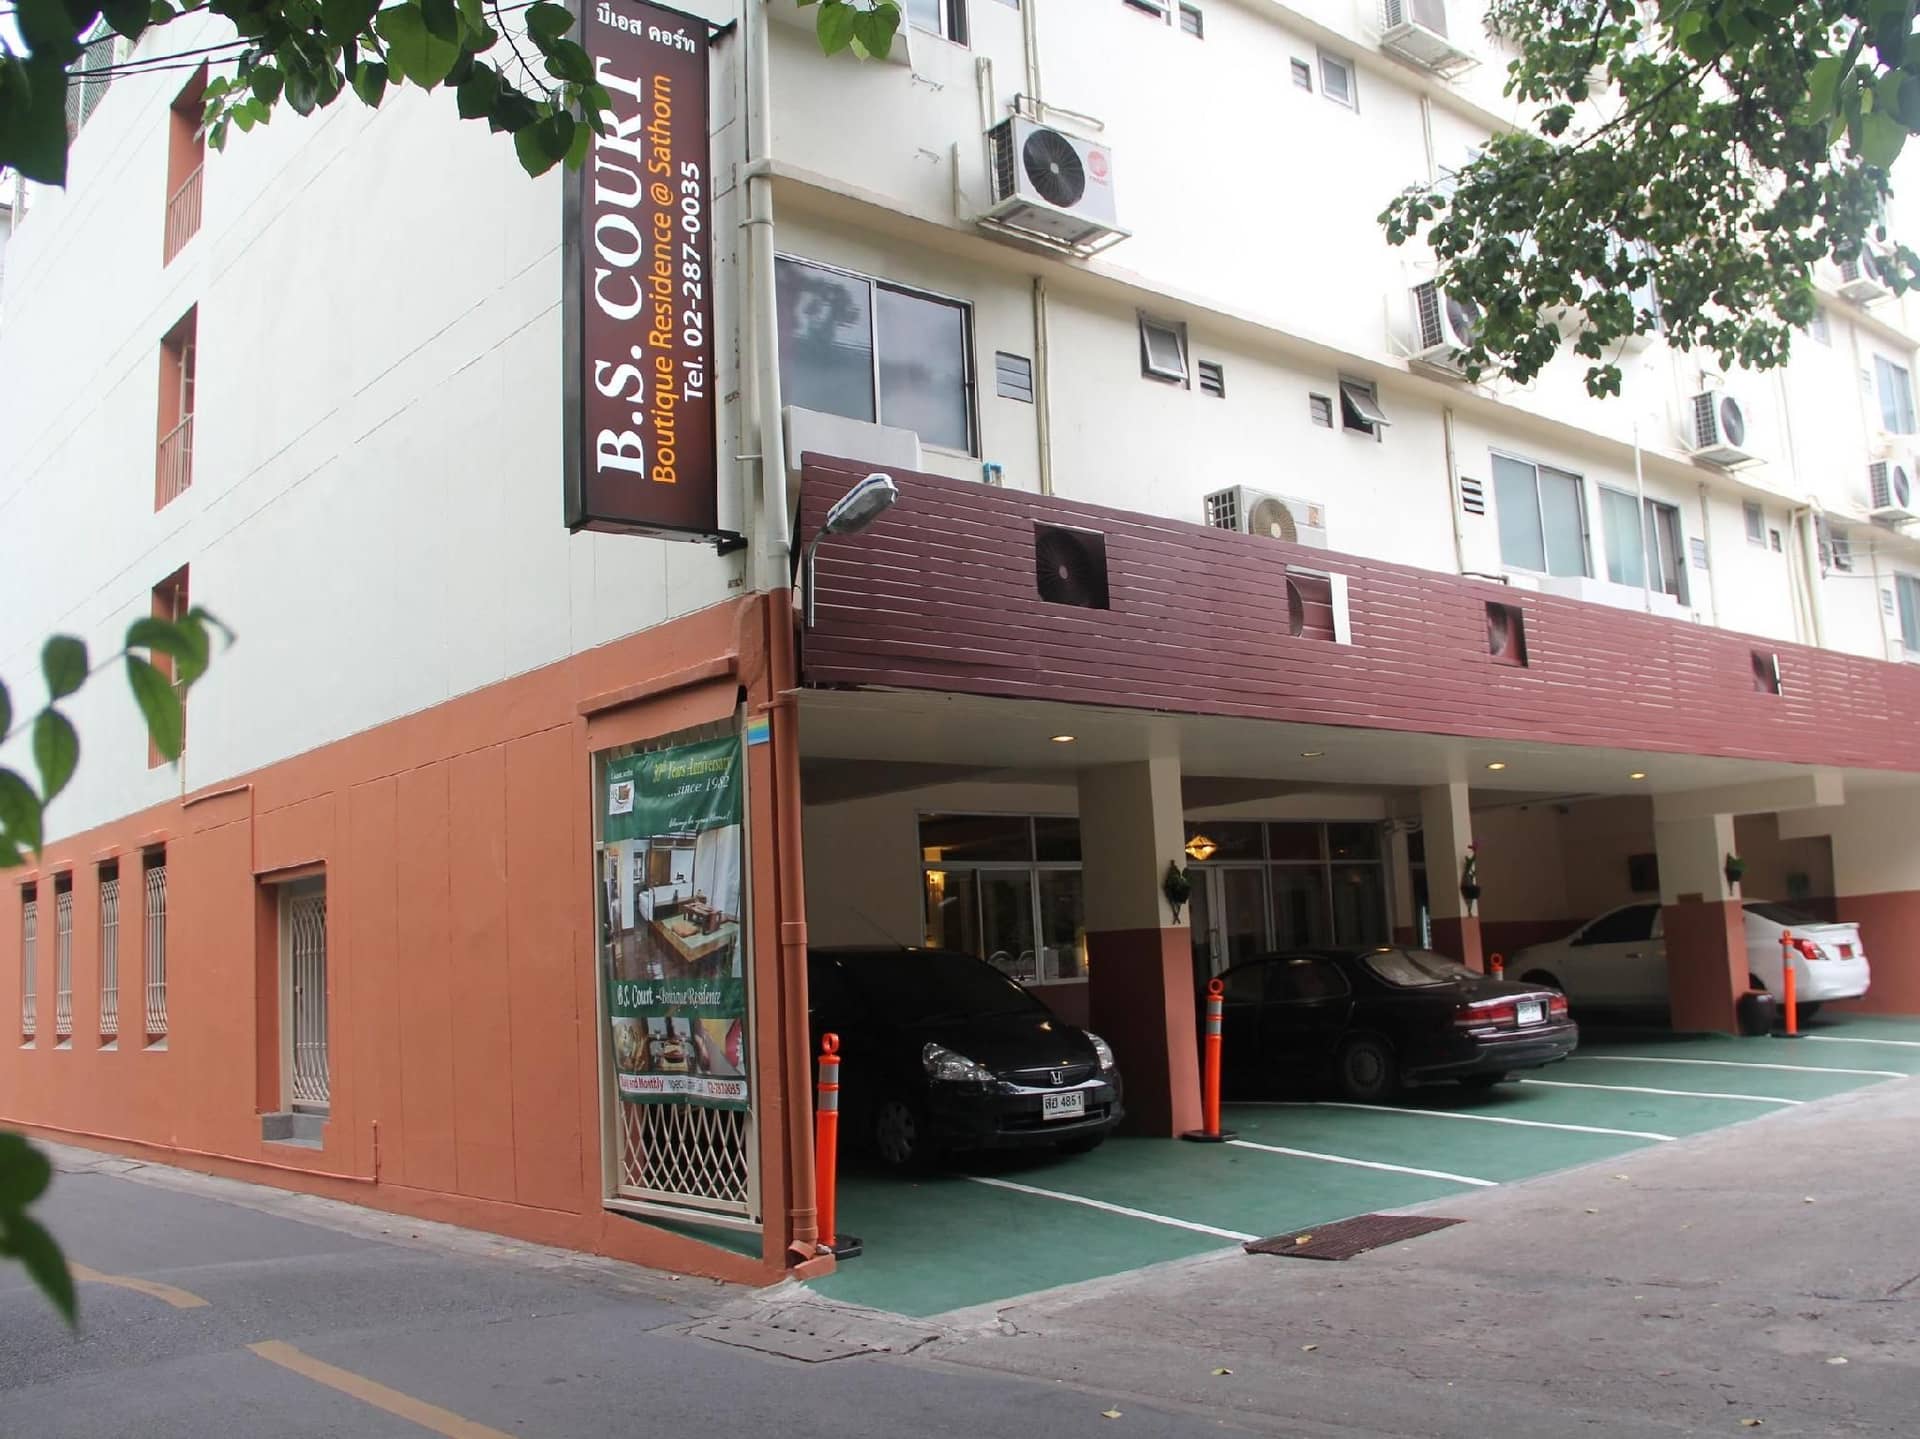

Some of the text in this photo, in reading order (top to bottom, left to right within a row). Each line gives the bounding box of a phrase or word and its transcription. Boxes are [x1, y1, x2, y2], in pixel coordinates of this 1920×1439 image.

[596, 2, 696, 54] บีเอส คอร์ท
[595, 56, 645, 479] B.S. COURT
[648, 75, 679, 484] Boutique Residence @ Sathorn
[681, 161, 704, 402] Tel. 02-287-0035
[632, 984, 654, 1008] Court
[1061, 1095, 1081, 1107] 4851
